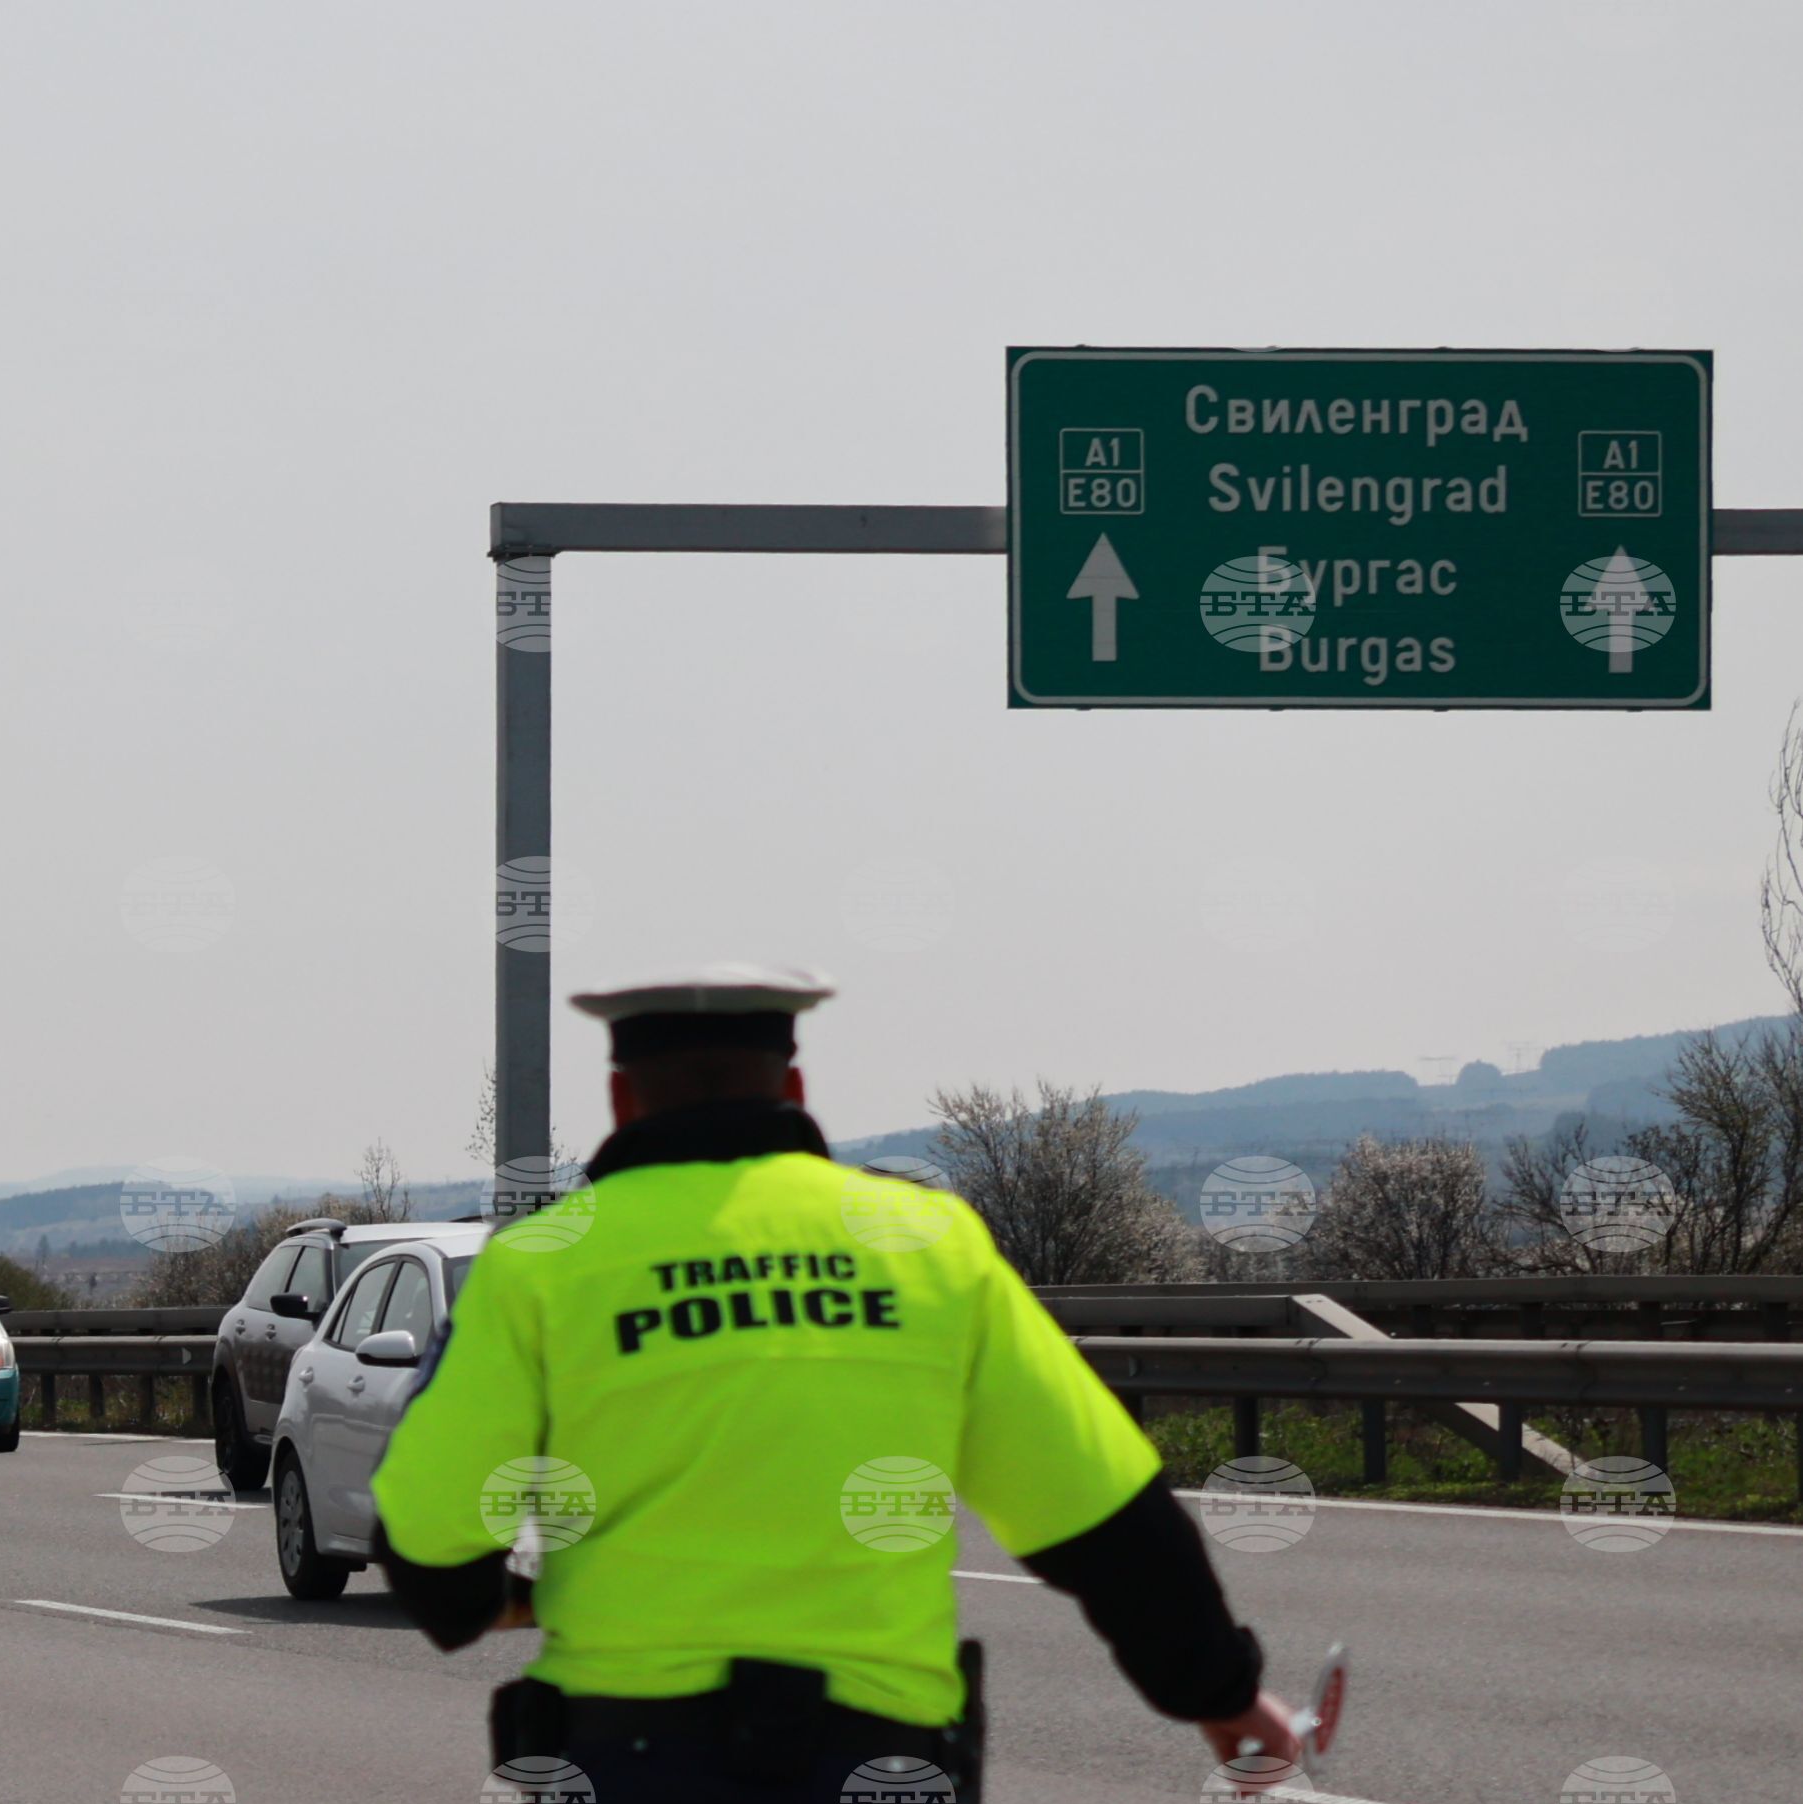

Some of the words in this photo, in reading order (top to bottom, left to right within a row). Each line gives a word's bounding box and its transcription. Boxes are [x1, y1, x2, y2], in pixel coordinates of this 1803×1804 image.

[1185, 384, 1528, 446] Свиленград
[1085, 437, 1121, 468] A1
[1602, 439, 1640, 470] A1
[1067, 477, 1137, 509] E80
[1208, 464, 1508, 525] Svilengrad
[1585, 480, 1654, 511] E80
[1257, 546, 1458, 607] Бургас
[1258, 624, 1456, 686] Burgas
[651, 1252, 857, 1292] TRAFFIC
[616, 1288, 901, 1355] POLICE
